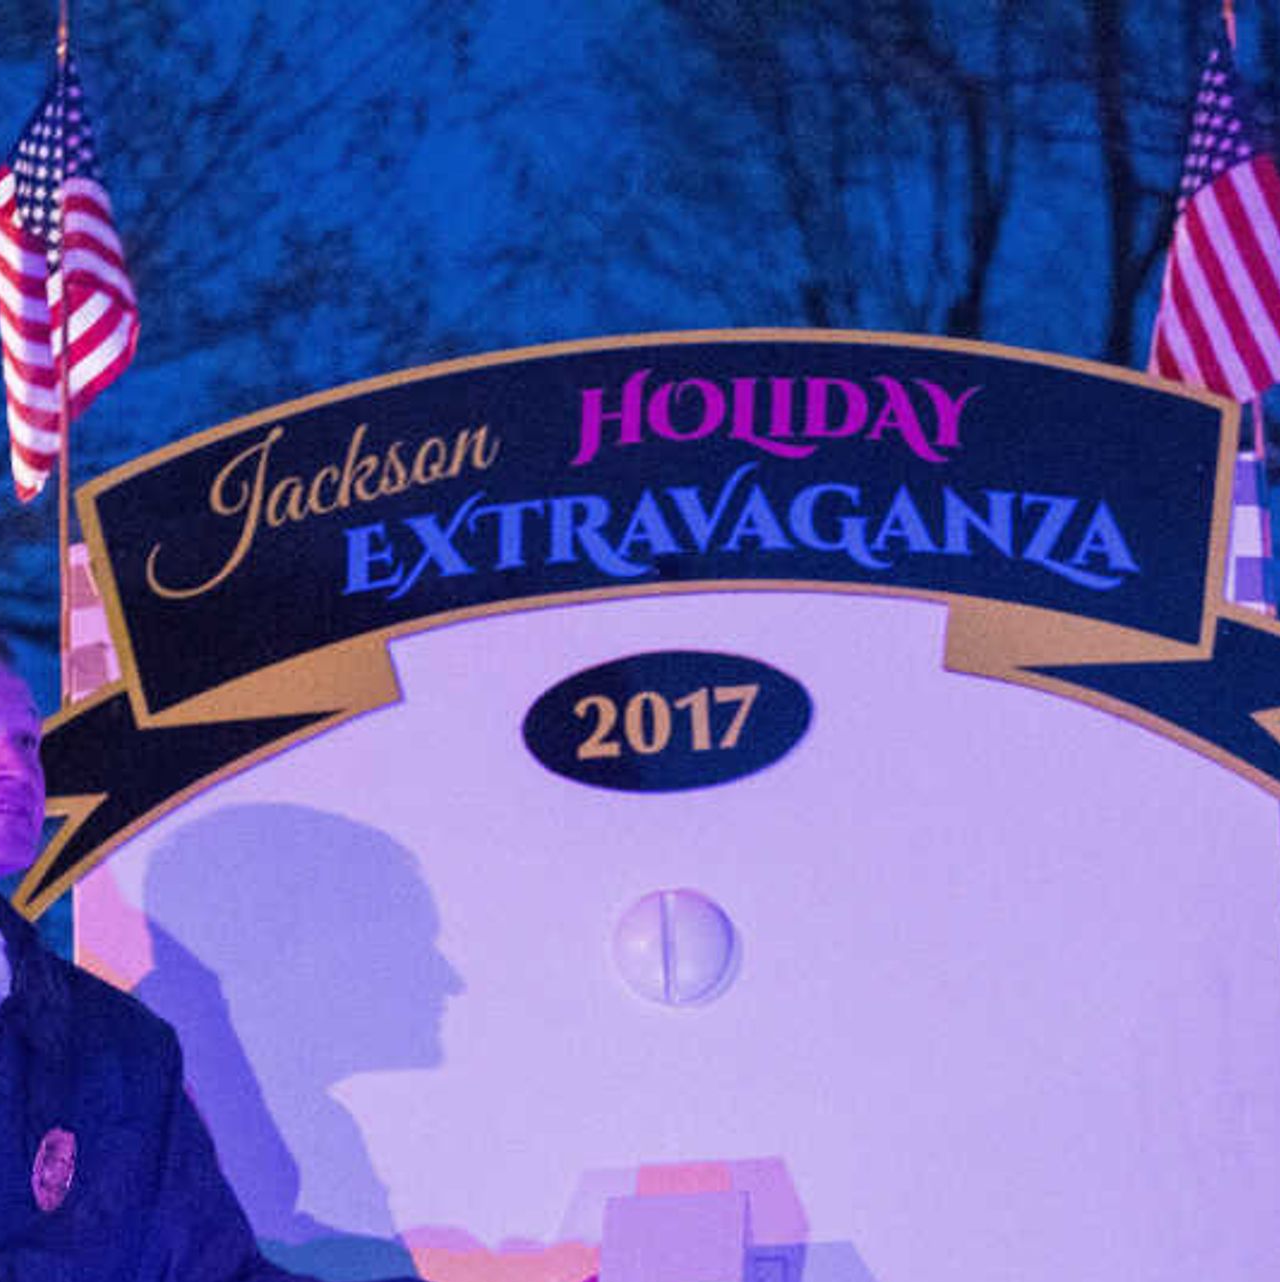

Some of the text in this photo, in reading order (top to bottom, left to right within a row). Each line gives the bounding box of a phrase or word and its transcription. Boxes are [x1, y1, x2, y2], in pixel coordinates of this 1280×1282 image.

[571, 368, 985, 467] HOLIDAY
[146, 423, 500, 598] Jackson
[342, 461, 1141, 600] EXTRAVAGANZA
[573, 683, 761, 761] 2017
